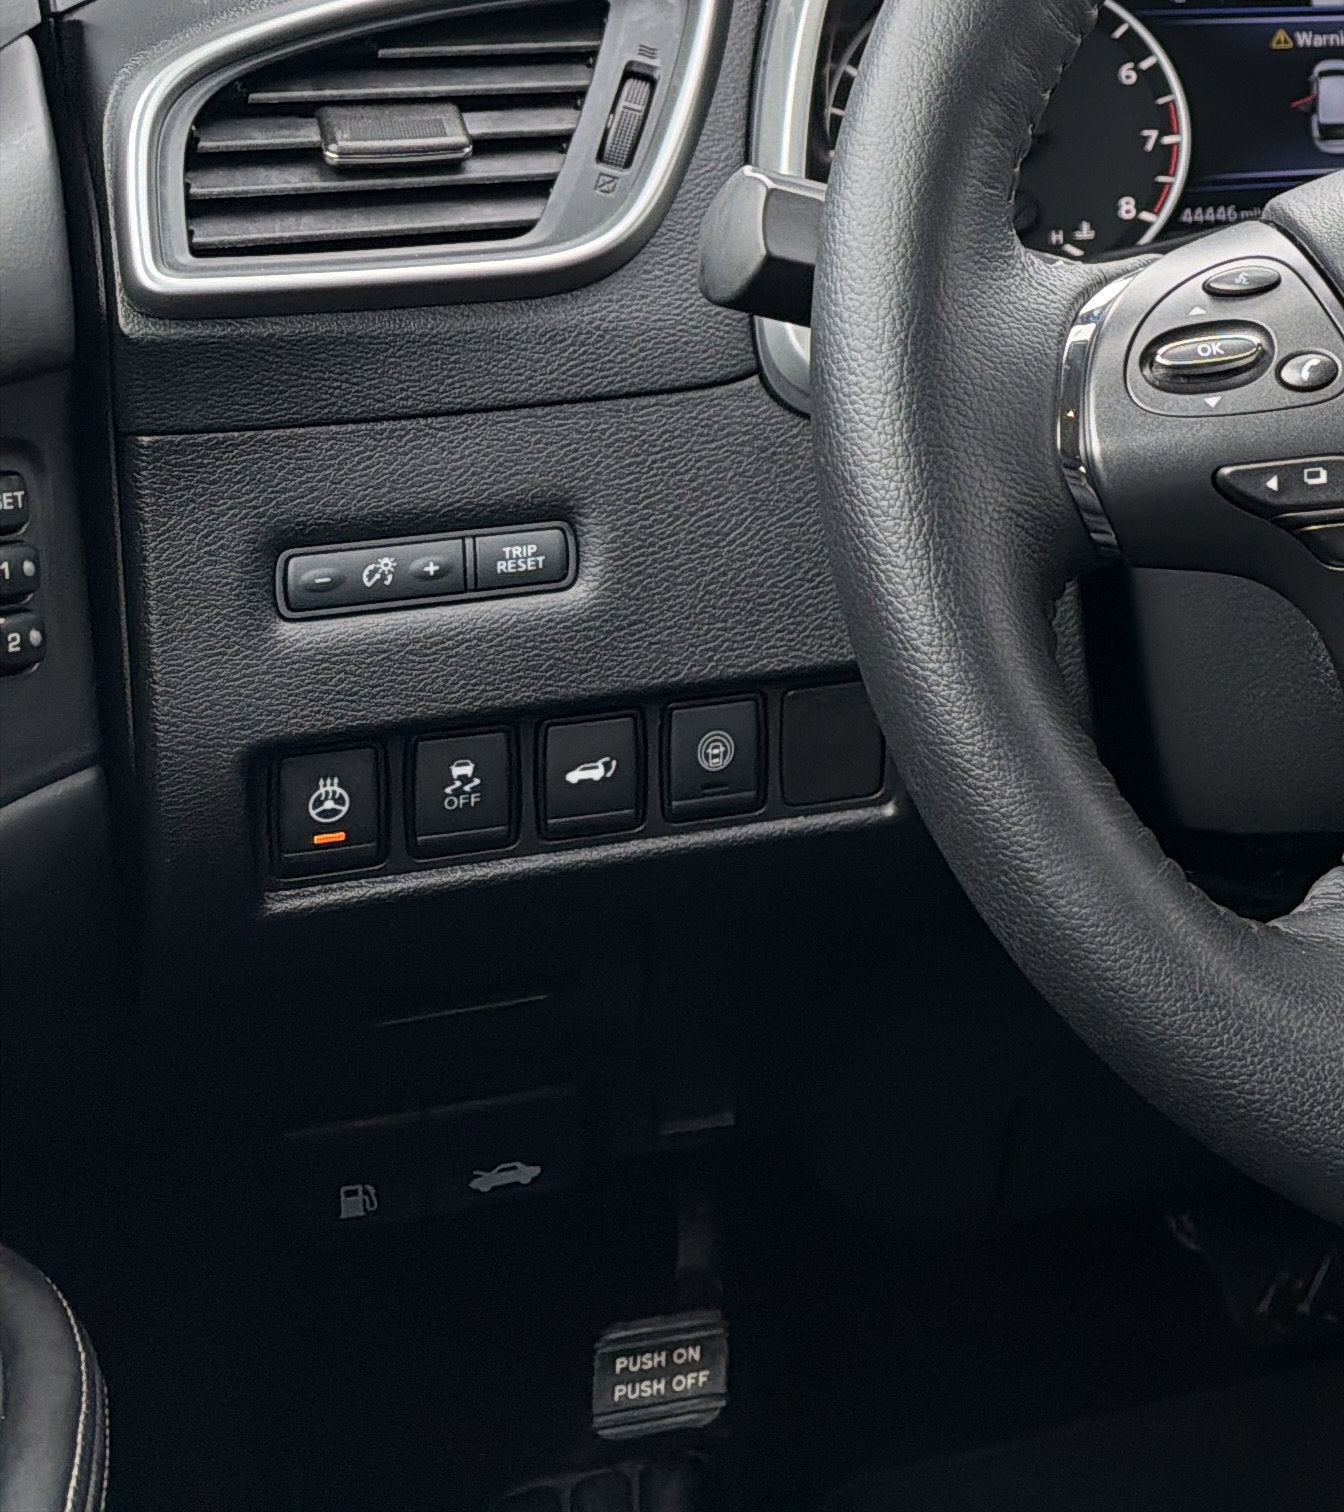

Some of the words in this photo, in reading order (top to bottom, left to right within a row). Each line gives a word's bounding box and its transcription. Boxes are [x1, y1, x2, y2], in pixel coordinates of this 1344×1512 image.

[1117, 62, 1138, 85] 6
[1140, 129, 1159, 152] 7
[1117, 196, 1137, 219] 8
[1181, 204, 1238, 224] 44446
[1048, 228, 1065, 245] H
[1197, 341, 1226, 357] OK
[0, 490, 25, 510] ET
[502, 544, 538, 560] TRIP
[0, 561, 10, 580] 1
[496, 555, 546, 575] RESET
[7, 632, 21, 653] 2
[443, 792, 481, 811] OFF
[615, 1351, 666, 1375] PUSH
[672, 1345, 701, 1364] ON
[613, 1377, 665, 1402] PUSH
[671, 1370, 710, 1392] OFF
